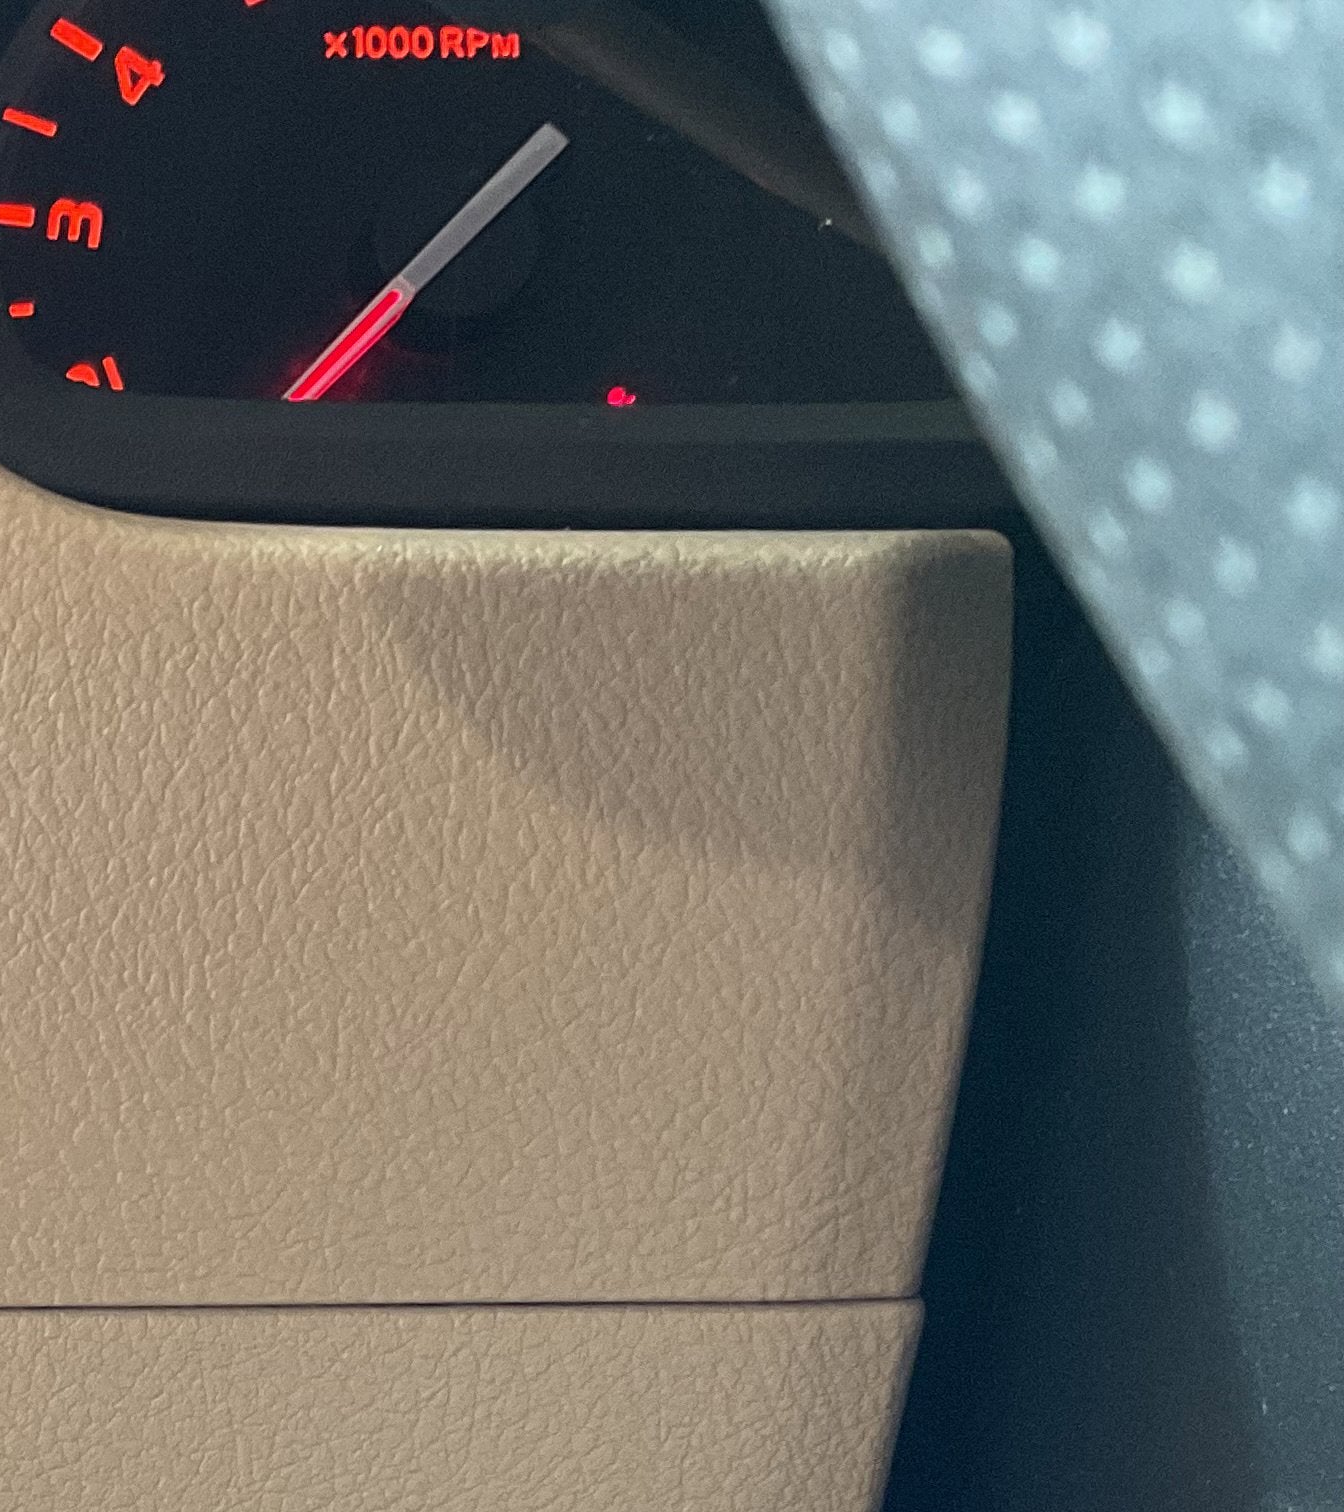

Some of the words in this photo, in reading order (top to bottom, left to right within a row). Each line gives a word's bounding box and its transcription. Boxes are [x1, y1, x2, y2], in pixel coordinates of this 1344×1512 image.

[439, 24, 521, 59] RPM
[114, 45, 166, 106] 4
[46, 197, 103, 249] 3
